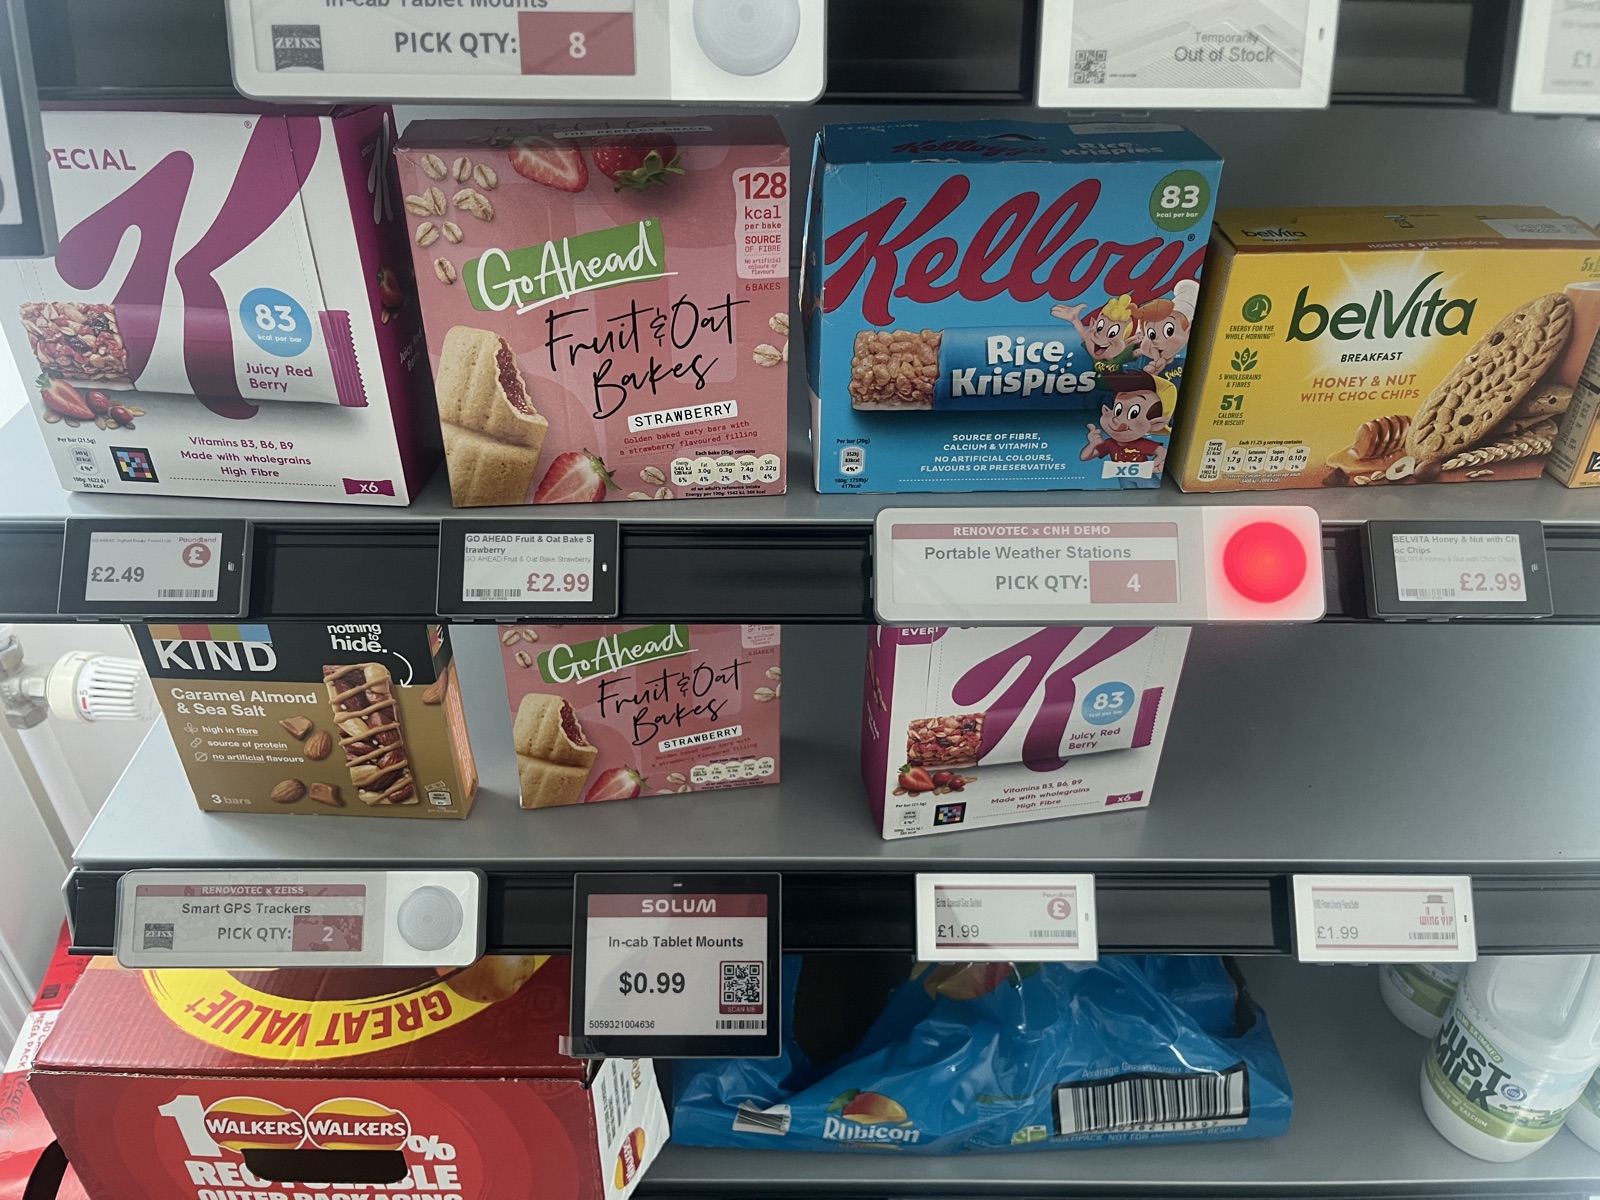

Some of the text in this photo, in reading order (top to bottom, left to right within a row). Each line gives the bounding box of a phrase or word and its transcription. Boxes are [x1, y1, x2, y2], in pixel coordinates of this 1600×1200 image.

[395, 31, 587, 59] PICK QTY: 8
[1174, 46, 1275, 63] Out of Stock
[46, 148, 137, 171] ECIAL
[738, 172, 787, 200] 128
[1160, 185, 1200, 209] 83
[744, 204, 782, 220] kcal
[744, 221, 782, 231] per bake
[744, 234, 782, 245] SOURCE
[745, 282, 781, 292] 6 BAKES
[255, 303, 297, 332] 83
[544, 293, 751, 372] Fruit & Oat
[987, 334, 1066, 366] Rice
[1340, 350, 1403, 363] BREAKFAST
[246, 361, 314, 379] Juicy Red
[249, 377, 289, 393] Berry
[592, 354, 719, 420] Bakes
[1311, 374, 1417, 389] HONEY & NUT
[1220, 394, 1244, 411] 51
[1300, 388, 1420, 403] WITH CHOC CHIPS
[634, 402, 732, 427] STRAWBERRY
[188, 436, 295, 450] Vitamins B3, B6, B9
[952, 432, 1041, 441] SOURCE OF FIBRE,
[943, 443, 987, 451] CALCIUM
[988, 443, 997, 451] &
[998, 442, 1039, 450] VITAMIN
[180, 450, 312, 465] Made with wholegrains
[934, 453, 1054, 463] NO ARTIFICIAL COLOURS,
[220, 466, 280, 477] High Fibre
[920, 462, 1066, 472] FLAVOURS OR PRESERVATIVES
[1115, 462, 1139, 477] x6
[359, 481, 379, 493] x6
[953, 525, 1111, 536] RENOVOTEC x CNH DEMO
[466, 535, 592, 543] GO AHEAD Fruit & Oat Bake S
[465, 546, 506, 555] trawberry
[925, 545, 1132, 560] Portable Weather Stations
[91, 566, 145, 583] £2.49
[1459, 572, 1521, 592] £2.99
[526, 572, 590, 593] £2.99
[995, 573, 1142, 592] PICK QTY: 4
[327, 624, 382, 635] nothing
[368, 632, 379, 641] to
[330, 634, 388, 653] hide.
[152, 639, 278, 672] KIND
[170, 687, 318, 704] Caramel Almond
[1092, 690, 1125, 711] 83
[176, 702, 267, 717] & Sea Salt
[631, 698, 729, 746] Bakes
[201, 725, 259, 735] high in fibre
[663, 726, 738, 749] STRAWBERRY
[1069, 727, 1121, 741] Juicy Red
[207, 740, 288, 750] source of protein
[1068, 740, 1098, 750] Berry
[226, 753, 265, 762] artificial
[265, 755, 305, 763] flavours
[211, 793, 252, 805] 3 bars
[201, 886, 263, 895] RENOVOTEC
[273, 886, 305, 894] ZEISS
[181, 902, 311, 914] Smart GPS Trackers
[641, 898, 717, 913] SOLUM
[217, 926, 334, 942] PICK QTY: 2
[937, 924, 980, 939] £1.99
[1316, 926, 1359, 940] £1.99
[608, 936, 744, 948] In-cab Tablet Mounts
[618, 970, 686, 996] $0.99
[727, 1005, 756, 1013] SCAN ME
[314, 989, 453, 1048] GREAT
[588, 1020, 656, 1029] 5059321004636
[206, 1117, 304, 1138] WALKERS
[308, 1118, 406, 1139] WALKERS
[822, 1116, 920, 1143] Rubicon
